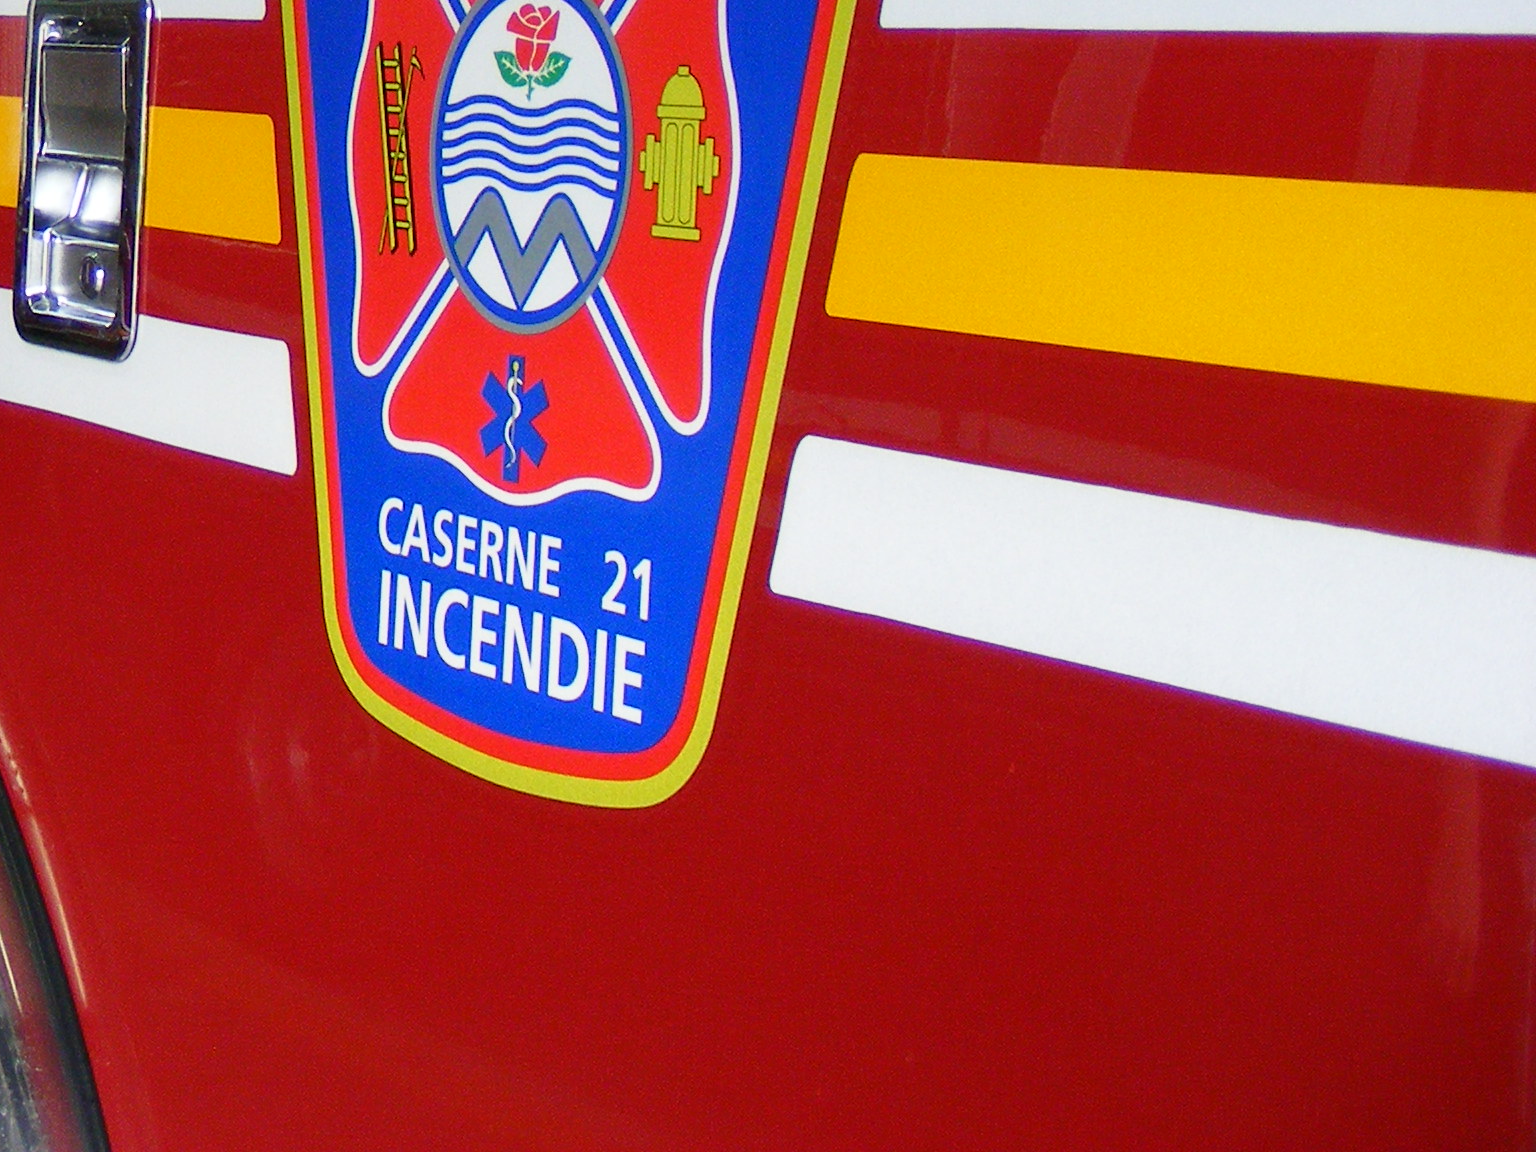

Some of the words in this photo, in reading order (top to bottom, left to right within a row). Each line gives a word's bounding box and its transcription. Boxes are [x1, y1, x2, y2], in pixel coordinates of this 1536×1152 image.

[378, 497, 563, 598] CASERNE
[600, 550, 653, 621] 21
[377, 570, 647, 725] INCENDIE
